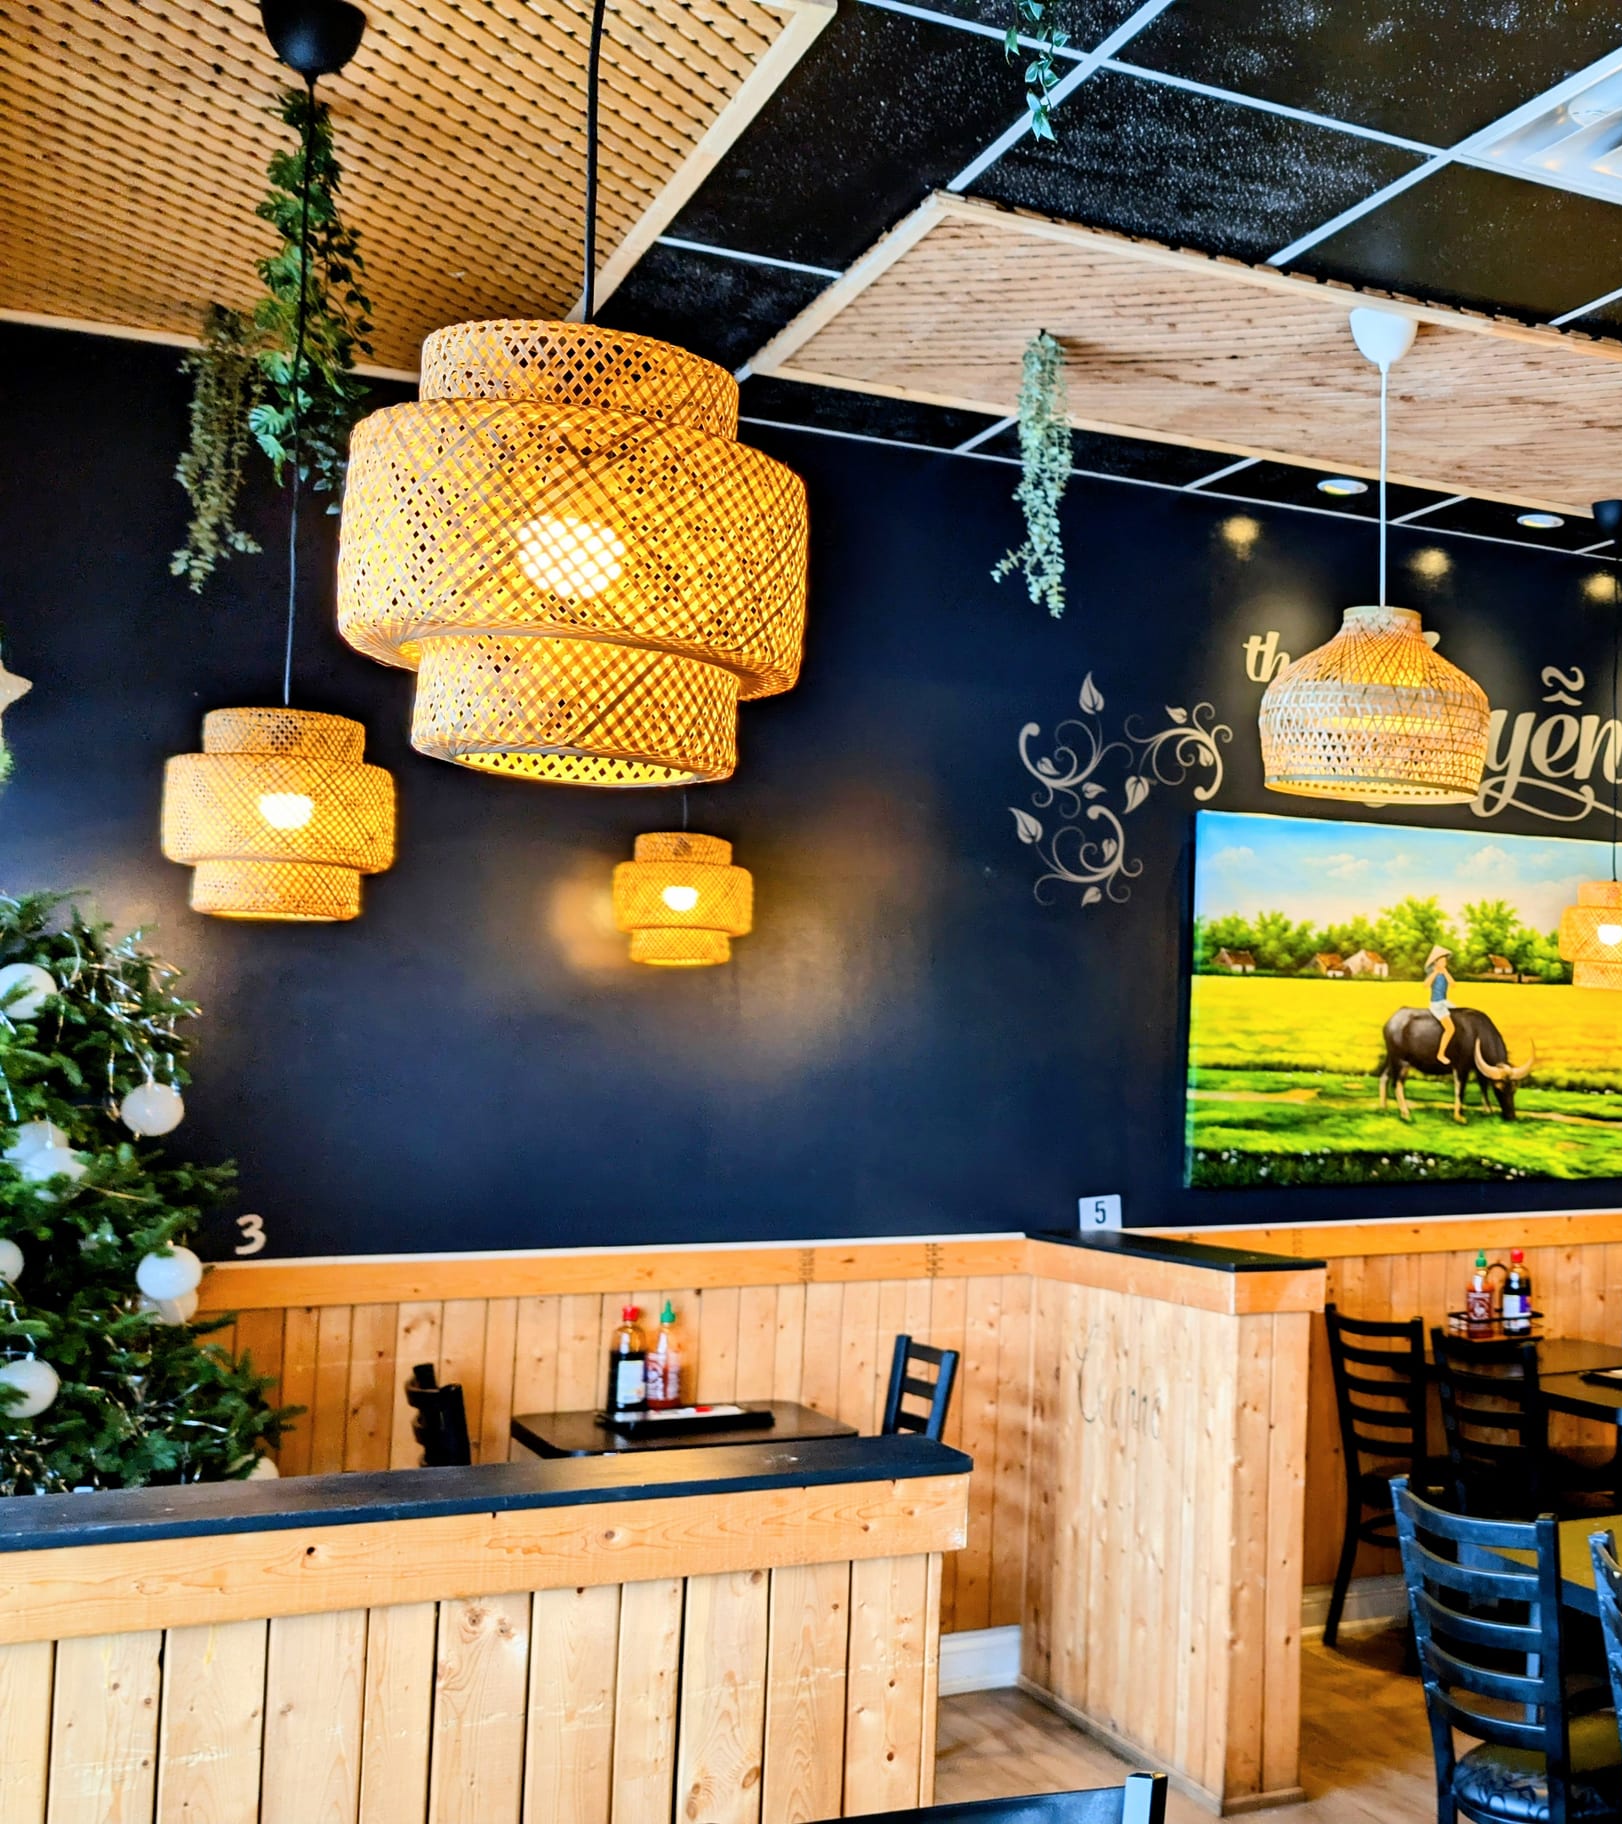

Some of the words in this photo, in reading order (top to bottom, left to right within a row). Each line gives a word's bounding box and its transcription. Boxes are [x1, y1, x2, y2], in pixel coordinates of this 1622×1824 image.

[1242, 631, 1290, 683] th
[1095, 1200, 1106, 1224] 5
[235, 1213, 267, 1256] 3
